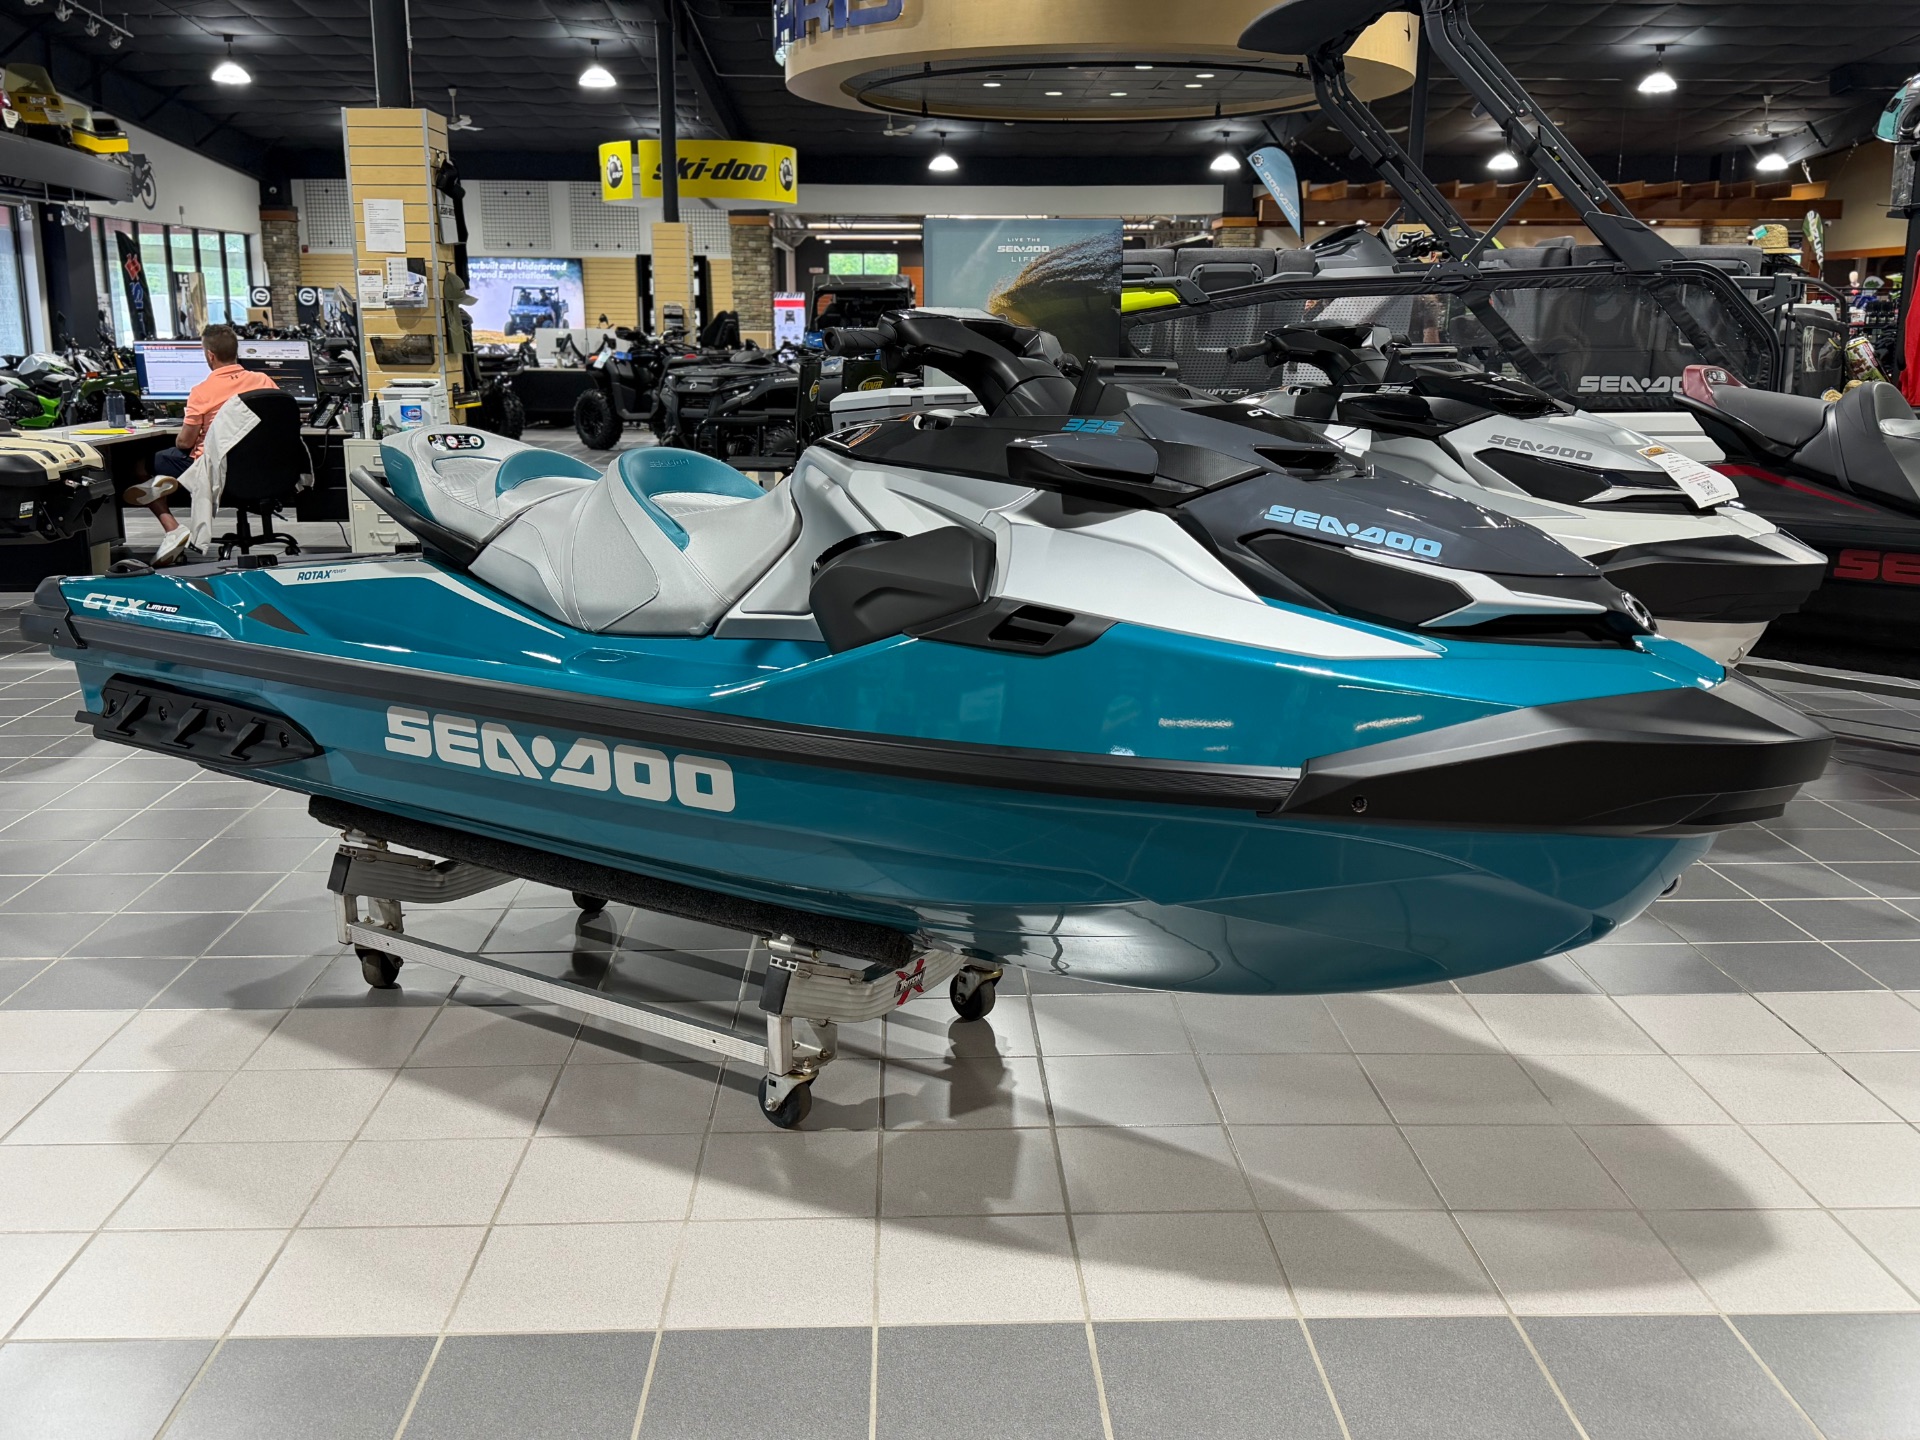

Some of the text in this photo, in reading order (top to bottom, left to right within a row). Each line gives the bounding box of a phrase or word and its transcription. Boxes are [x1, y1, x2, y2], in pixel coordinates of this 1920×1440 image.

[468, 261, 568, 272] verbuilt and Underpriced
[1203, 388, 1250, 396] WITCH
[1375, 384, 1414, 395] 325
[1061, 418, 1125, 436] 325
[297, 569, 332, 581] ROTAX
[82, 592, 178, 616] GTX LIMITED
